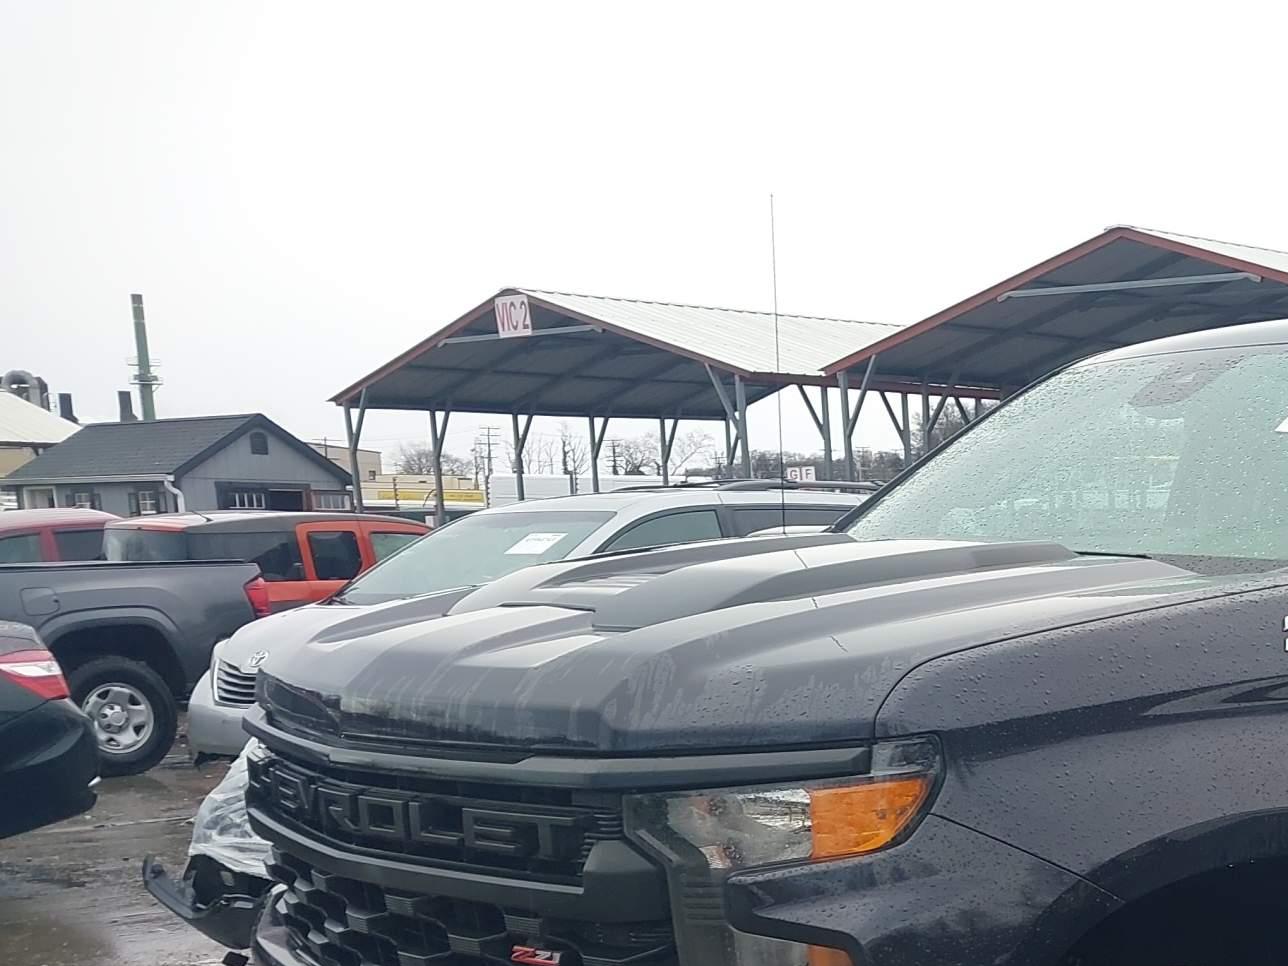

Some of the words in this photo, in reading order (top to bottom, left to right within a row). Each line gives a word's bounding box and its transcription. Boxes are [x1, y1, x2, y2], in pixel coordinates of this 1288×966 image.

[496, 301, 519, 333] VIC
[519, 299, 530, 330] 2
[789, 468, 799, 480] G
